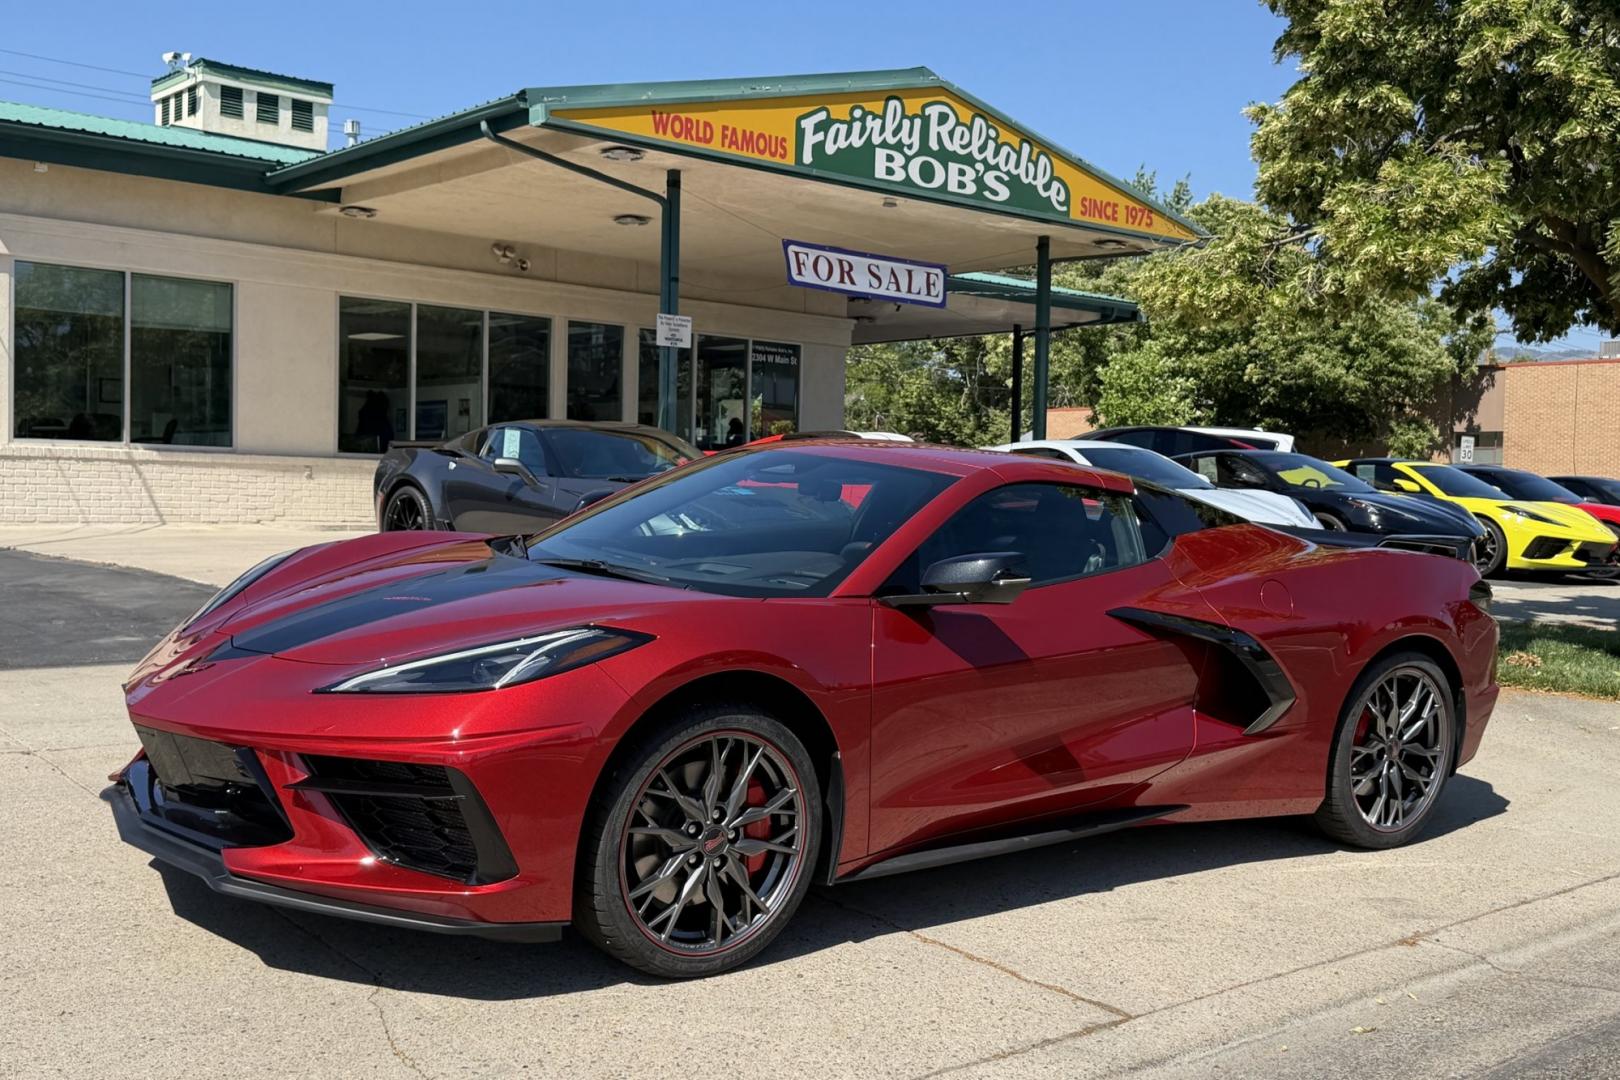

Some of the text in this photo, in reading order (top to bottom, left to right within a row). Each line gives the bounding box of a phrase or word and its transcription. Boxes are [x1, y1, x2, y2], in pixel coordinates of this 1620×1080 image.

[651, 109, 787, 160] WORLD FAMOUS
[800, 99, 1068, 212] Fairly Reliable
[874, 147, 1011, 202] BOB'S
[1080, 195, 1154, 229] SINCE 1975
[792, 250, 940, 299] FOR SALE
[767, 354, 775, 364] W
[1461, 449, 1472, 459] 30
